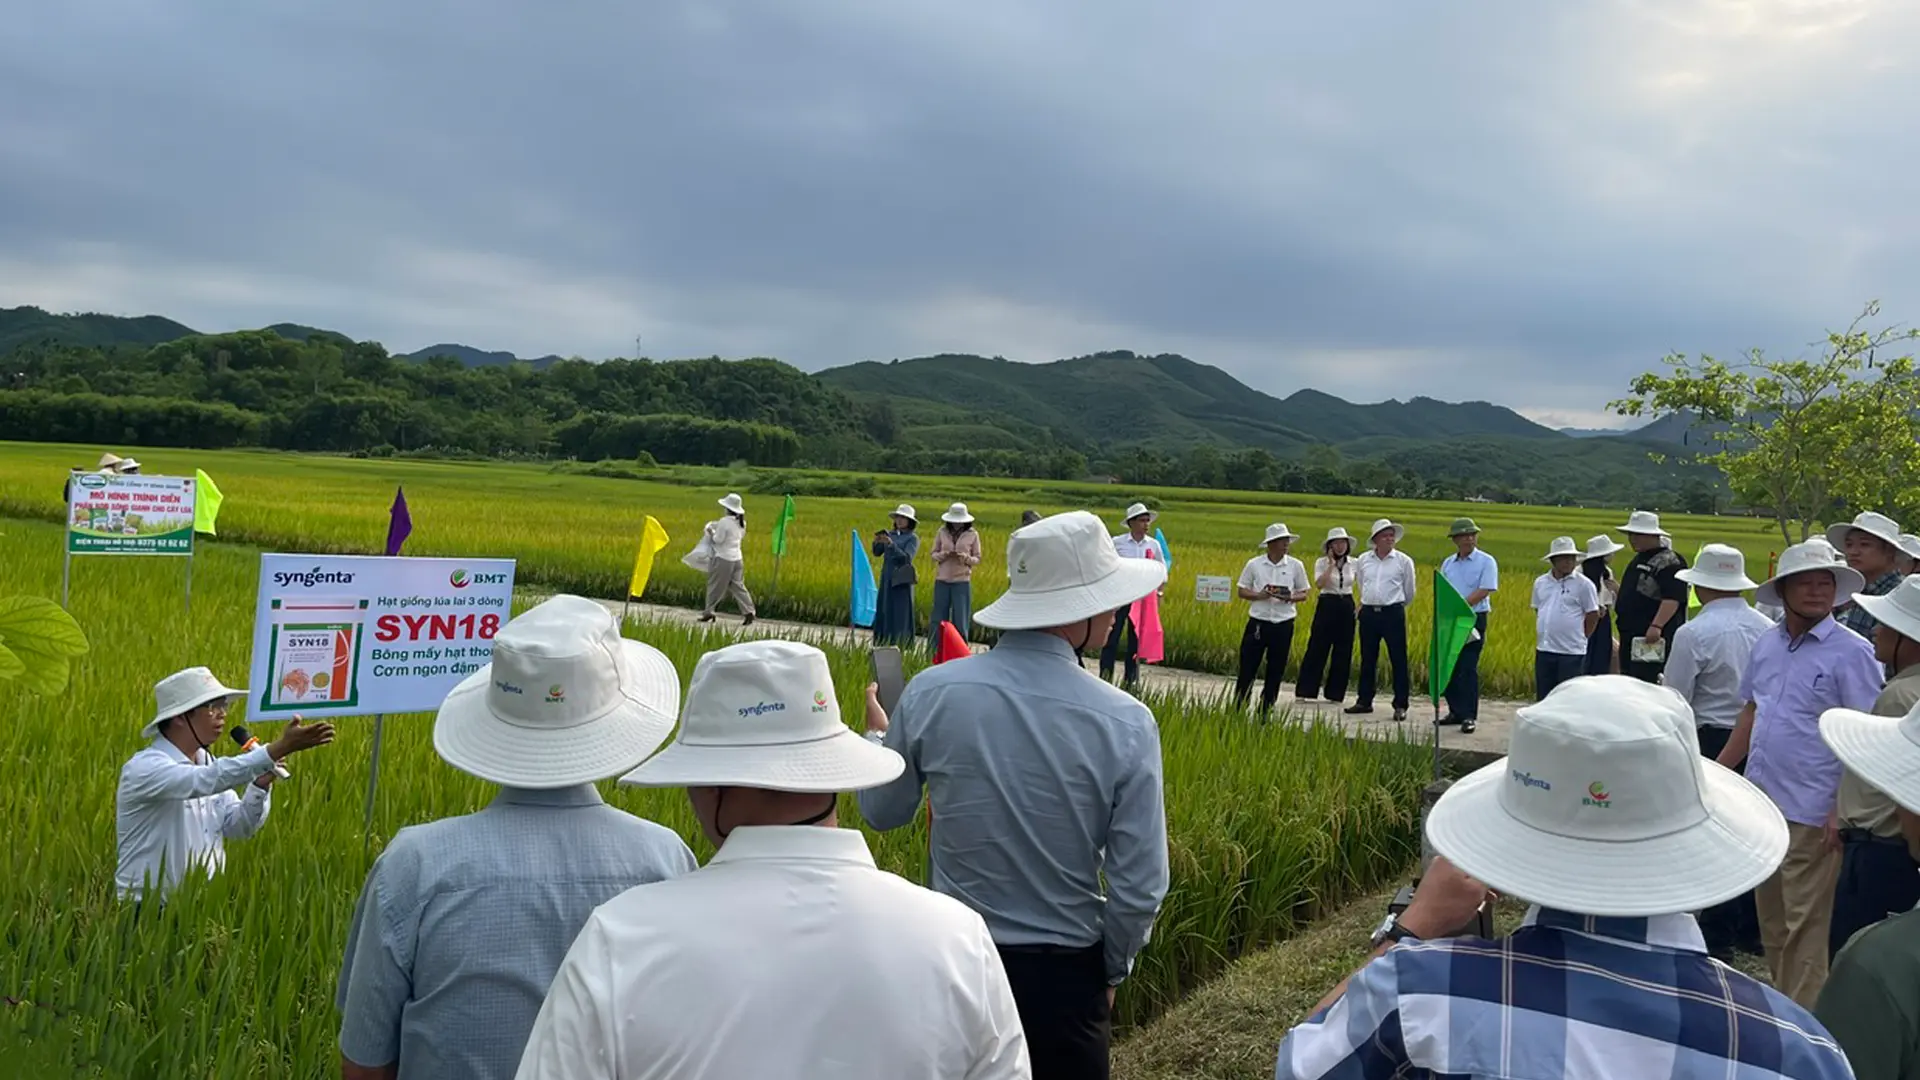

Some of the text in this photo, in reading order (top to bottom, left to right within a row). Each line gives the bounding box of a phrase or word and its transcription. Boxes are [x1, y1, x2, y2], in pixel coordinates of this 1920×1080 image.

[274, 567, 353, 588] syngenta
[474, 573, 507, 584] BMT
[377, 595, 504, 608] Hạt giống lúa lai 3 dòng
[375, 613, 500, 642] SYN18
[289, 638, 329, 647] SYN18
[372, 648, 409, 661] Bông
[444, 647, 466, 660] hạt
[373, 661, 480, 678] Cơm ngon đậm
[738, 701, 786, 718] syngenta
[1512, 769, 1551, 791] syngenta
